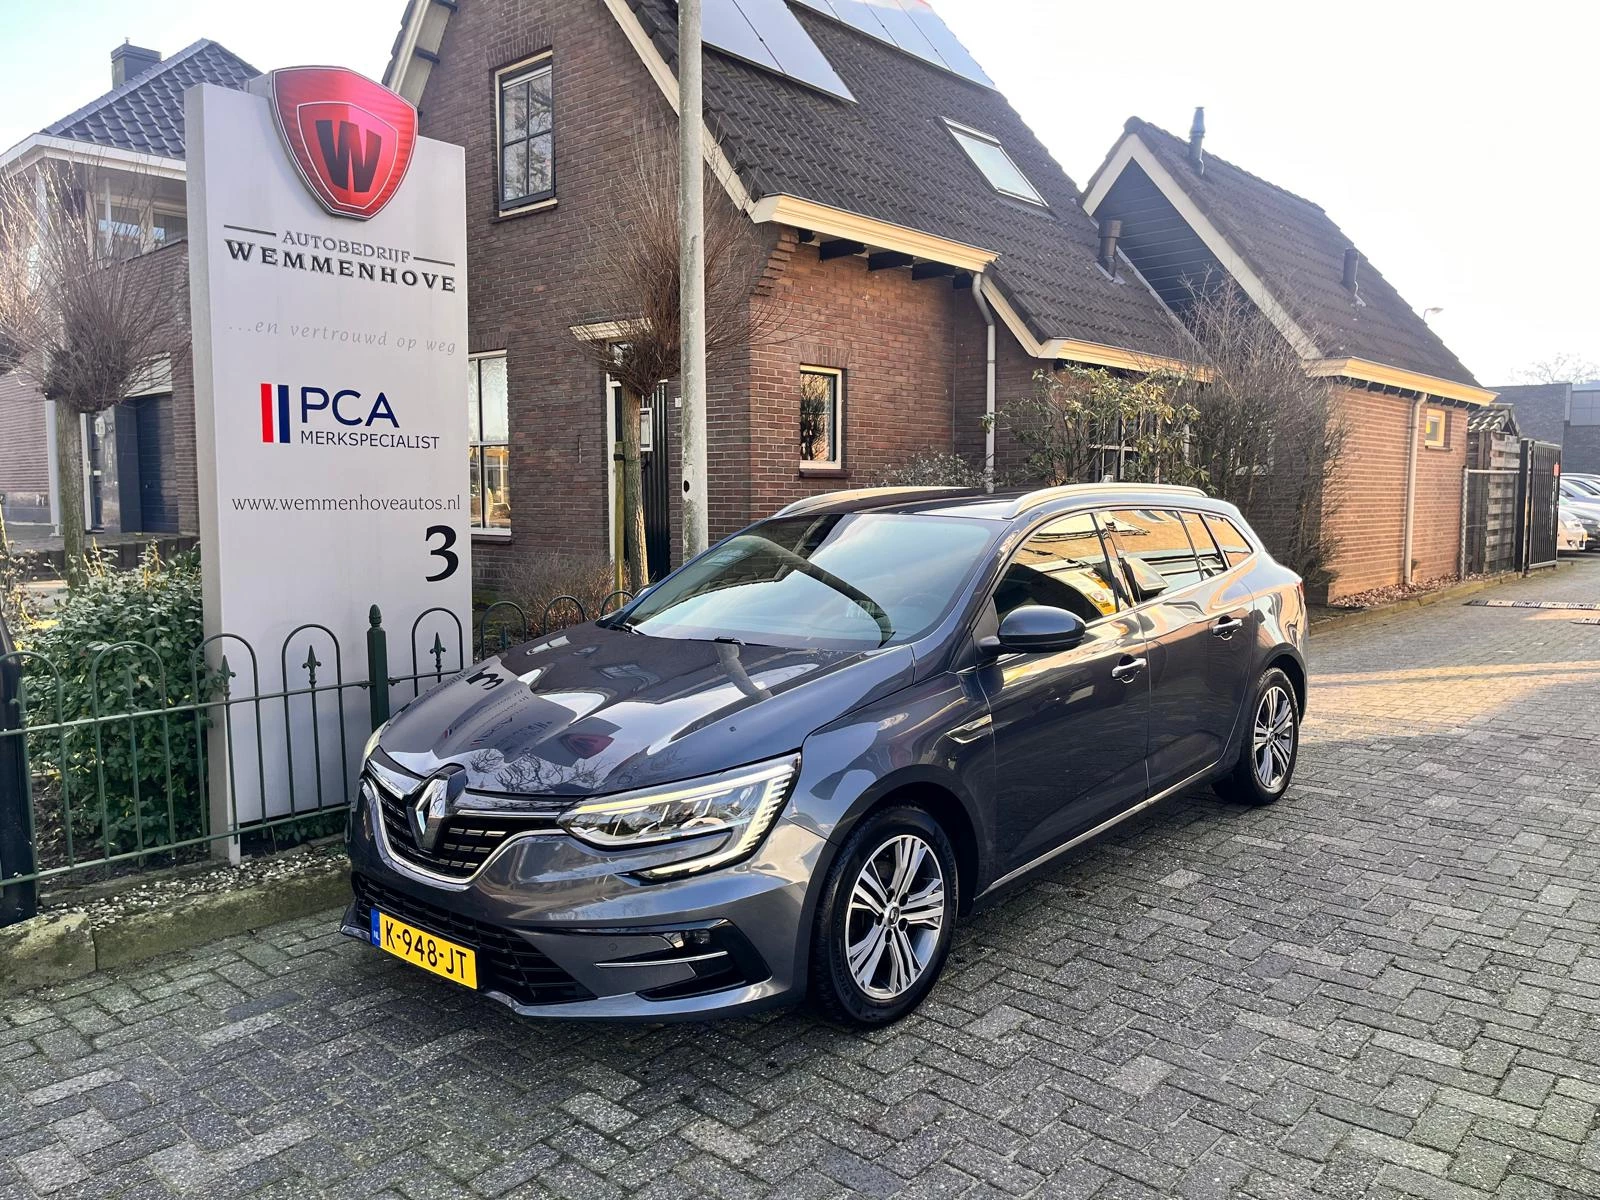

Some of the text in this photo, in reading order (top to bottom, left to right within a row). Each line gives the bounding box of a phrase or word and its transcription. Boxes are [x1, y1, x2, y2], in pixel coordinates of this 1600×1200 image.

[315, 119, 382, 193] W
[224, 239, 456, 294] WEMMENHOVE
[282, 230, 411, 264] AUTOBEDRIJF
[290, 325, 388, 347] vertrouwd
[396, 337, 417, 352] op
[425, 340, 456, 356] weg
[300, 386, 400, 429] PCA
[300, 430, 440, 450] MERKSPECIALIST
[231, 494, 461, 511] www.wemmenhoveautos.nl
[424, 524, 459, 583] 3
[385, 919, 467, 979] K-948-JT
